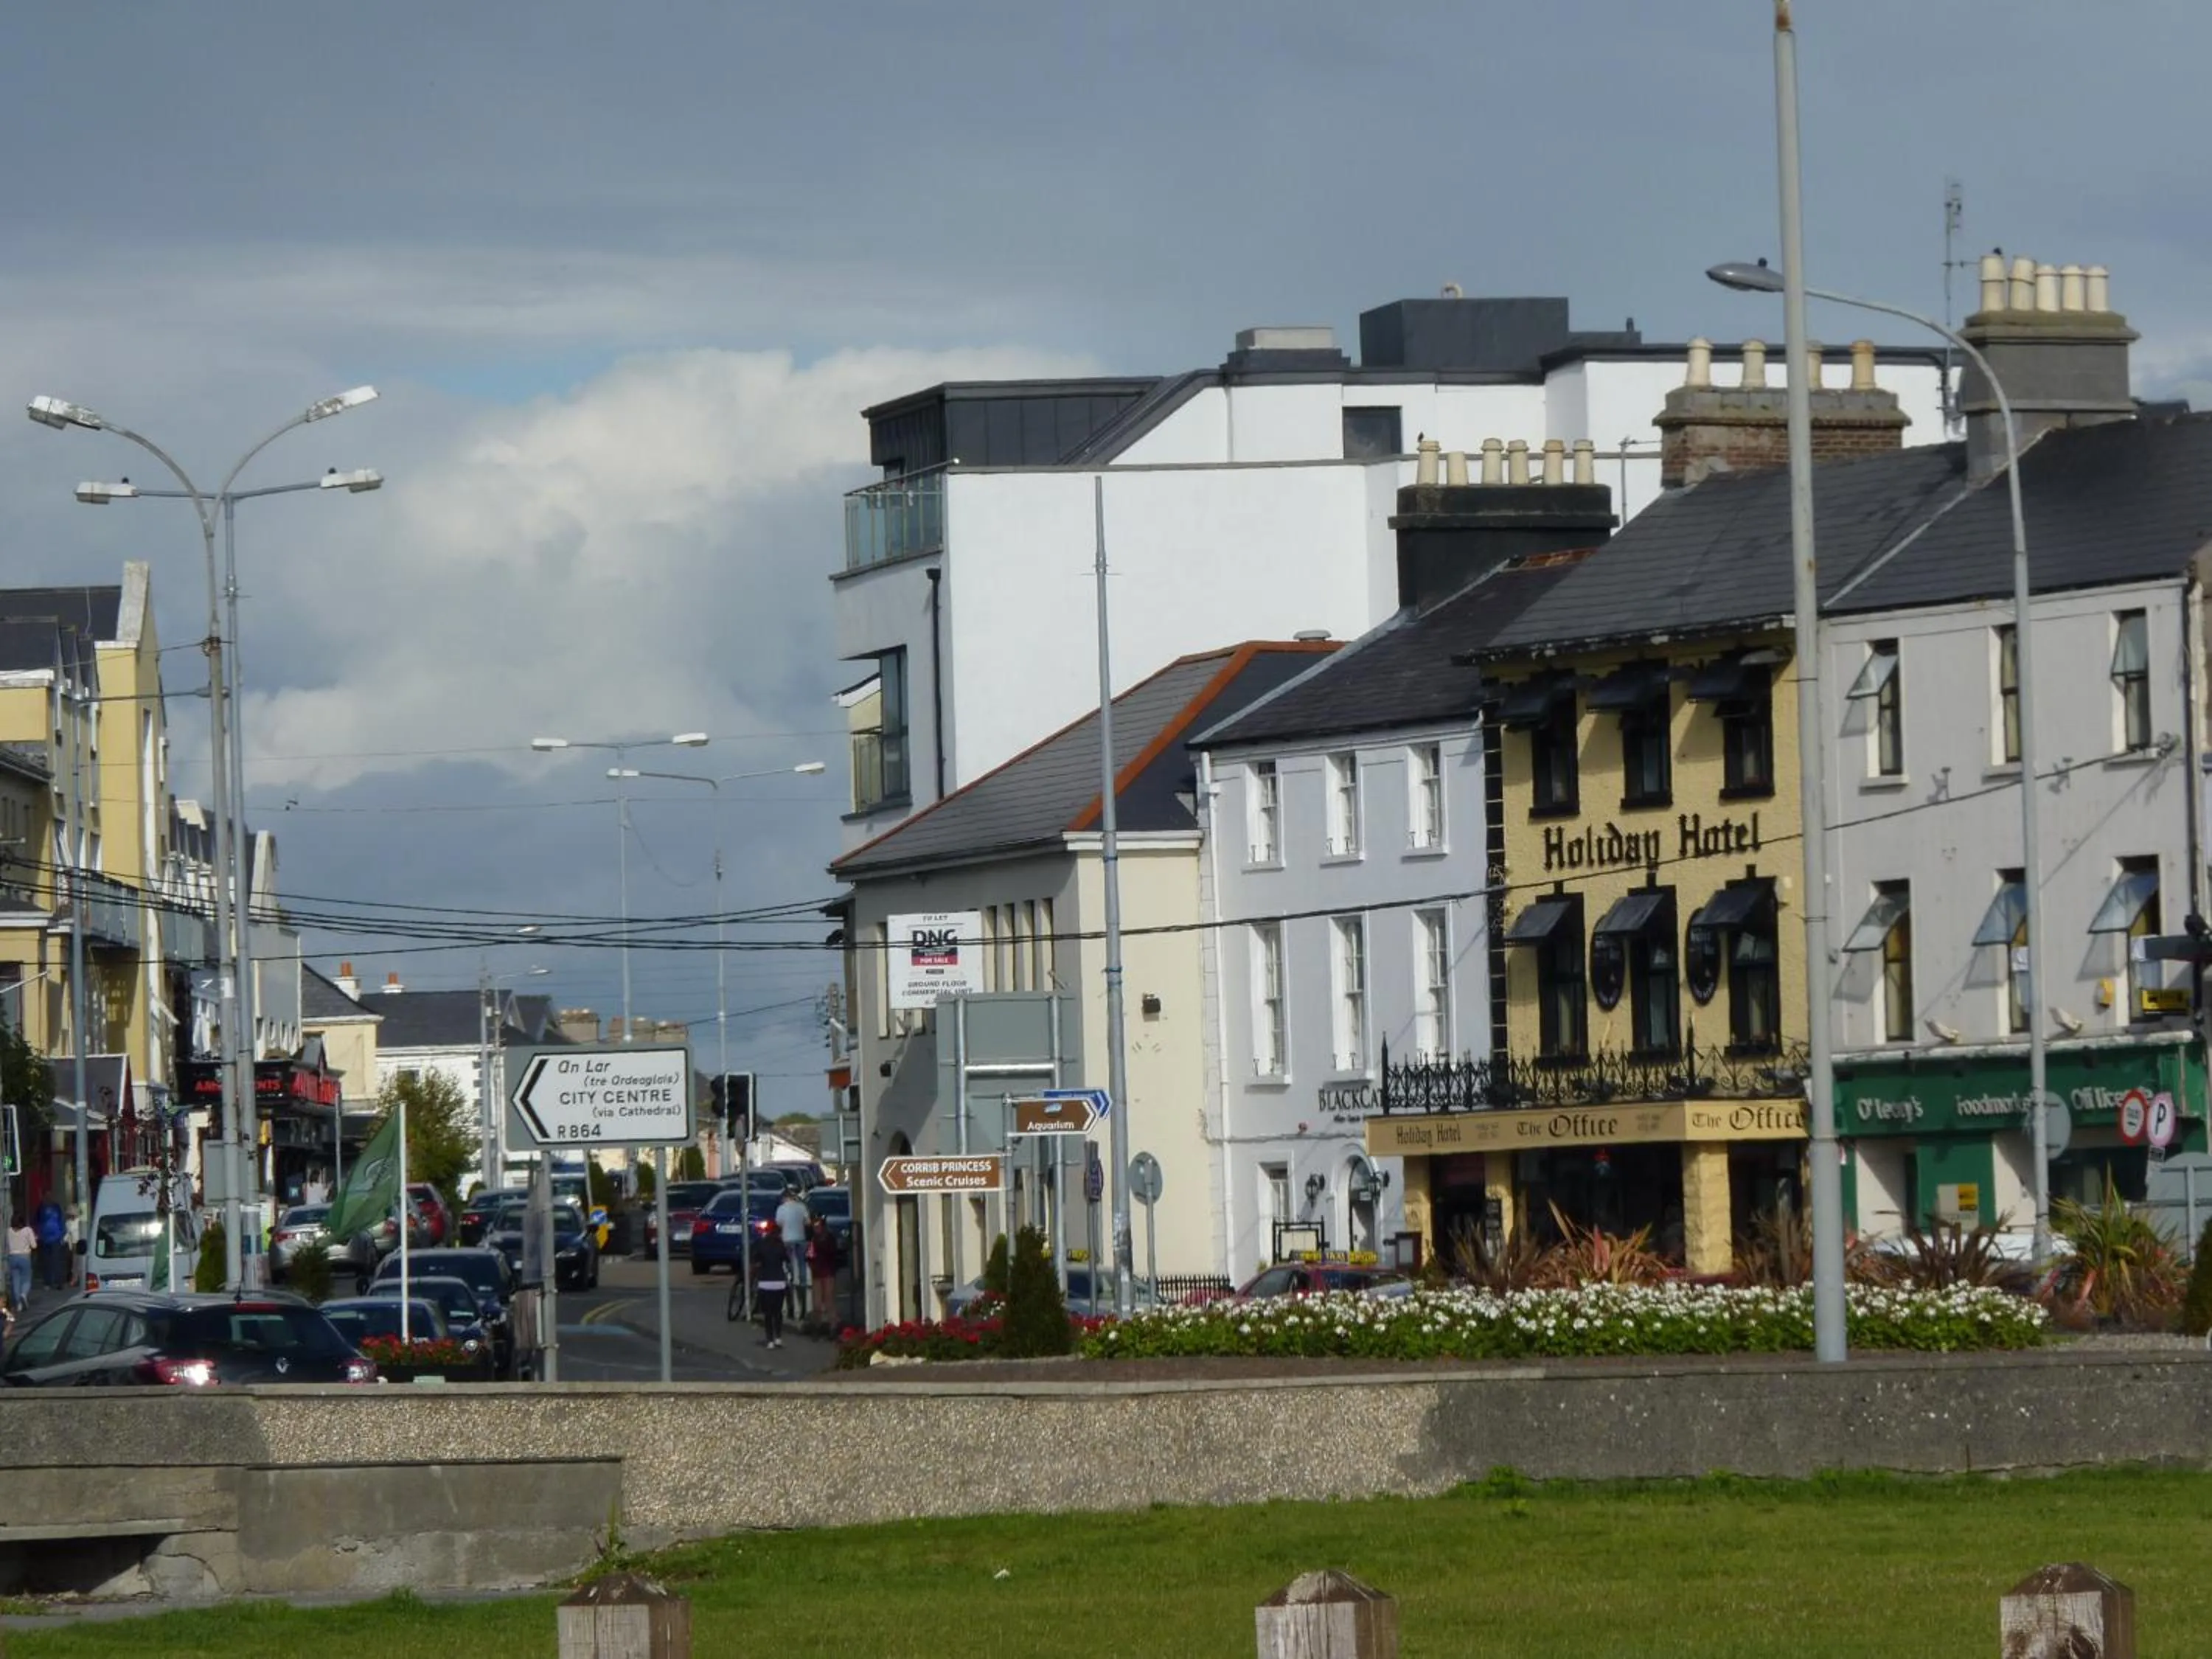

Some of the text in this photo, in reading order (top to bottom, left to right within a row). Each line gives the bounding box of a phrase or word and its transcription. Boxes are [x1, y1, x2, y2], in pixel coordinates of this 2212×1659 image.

[1544, 812, 1761, 872] Holiday Hotel
[912, 929, 958, 947] DNG
[560, 1089, 672, 1105] CITY CENTRE
[592, 1105, 682, 1119] (via Cathedral)
[1691, 1107, 1805, 1132] The Office
[1027, 1121, 1075, 1132] Aquarium
[1517, 1121, 1542, 1136] The
[1548, 1114, 1618, 1138] Office
[1396, 1124, 1433, 1148] Holiday
[1437, 1123, 1461, 1144] Hotel
[900, 1161, 992, 1174] CORRIB PRINCESS
[906, 1175, 987, 1187] Scenic Cruises
